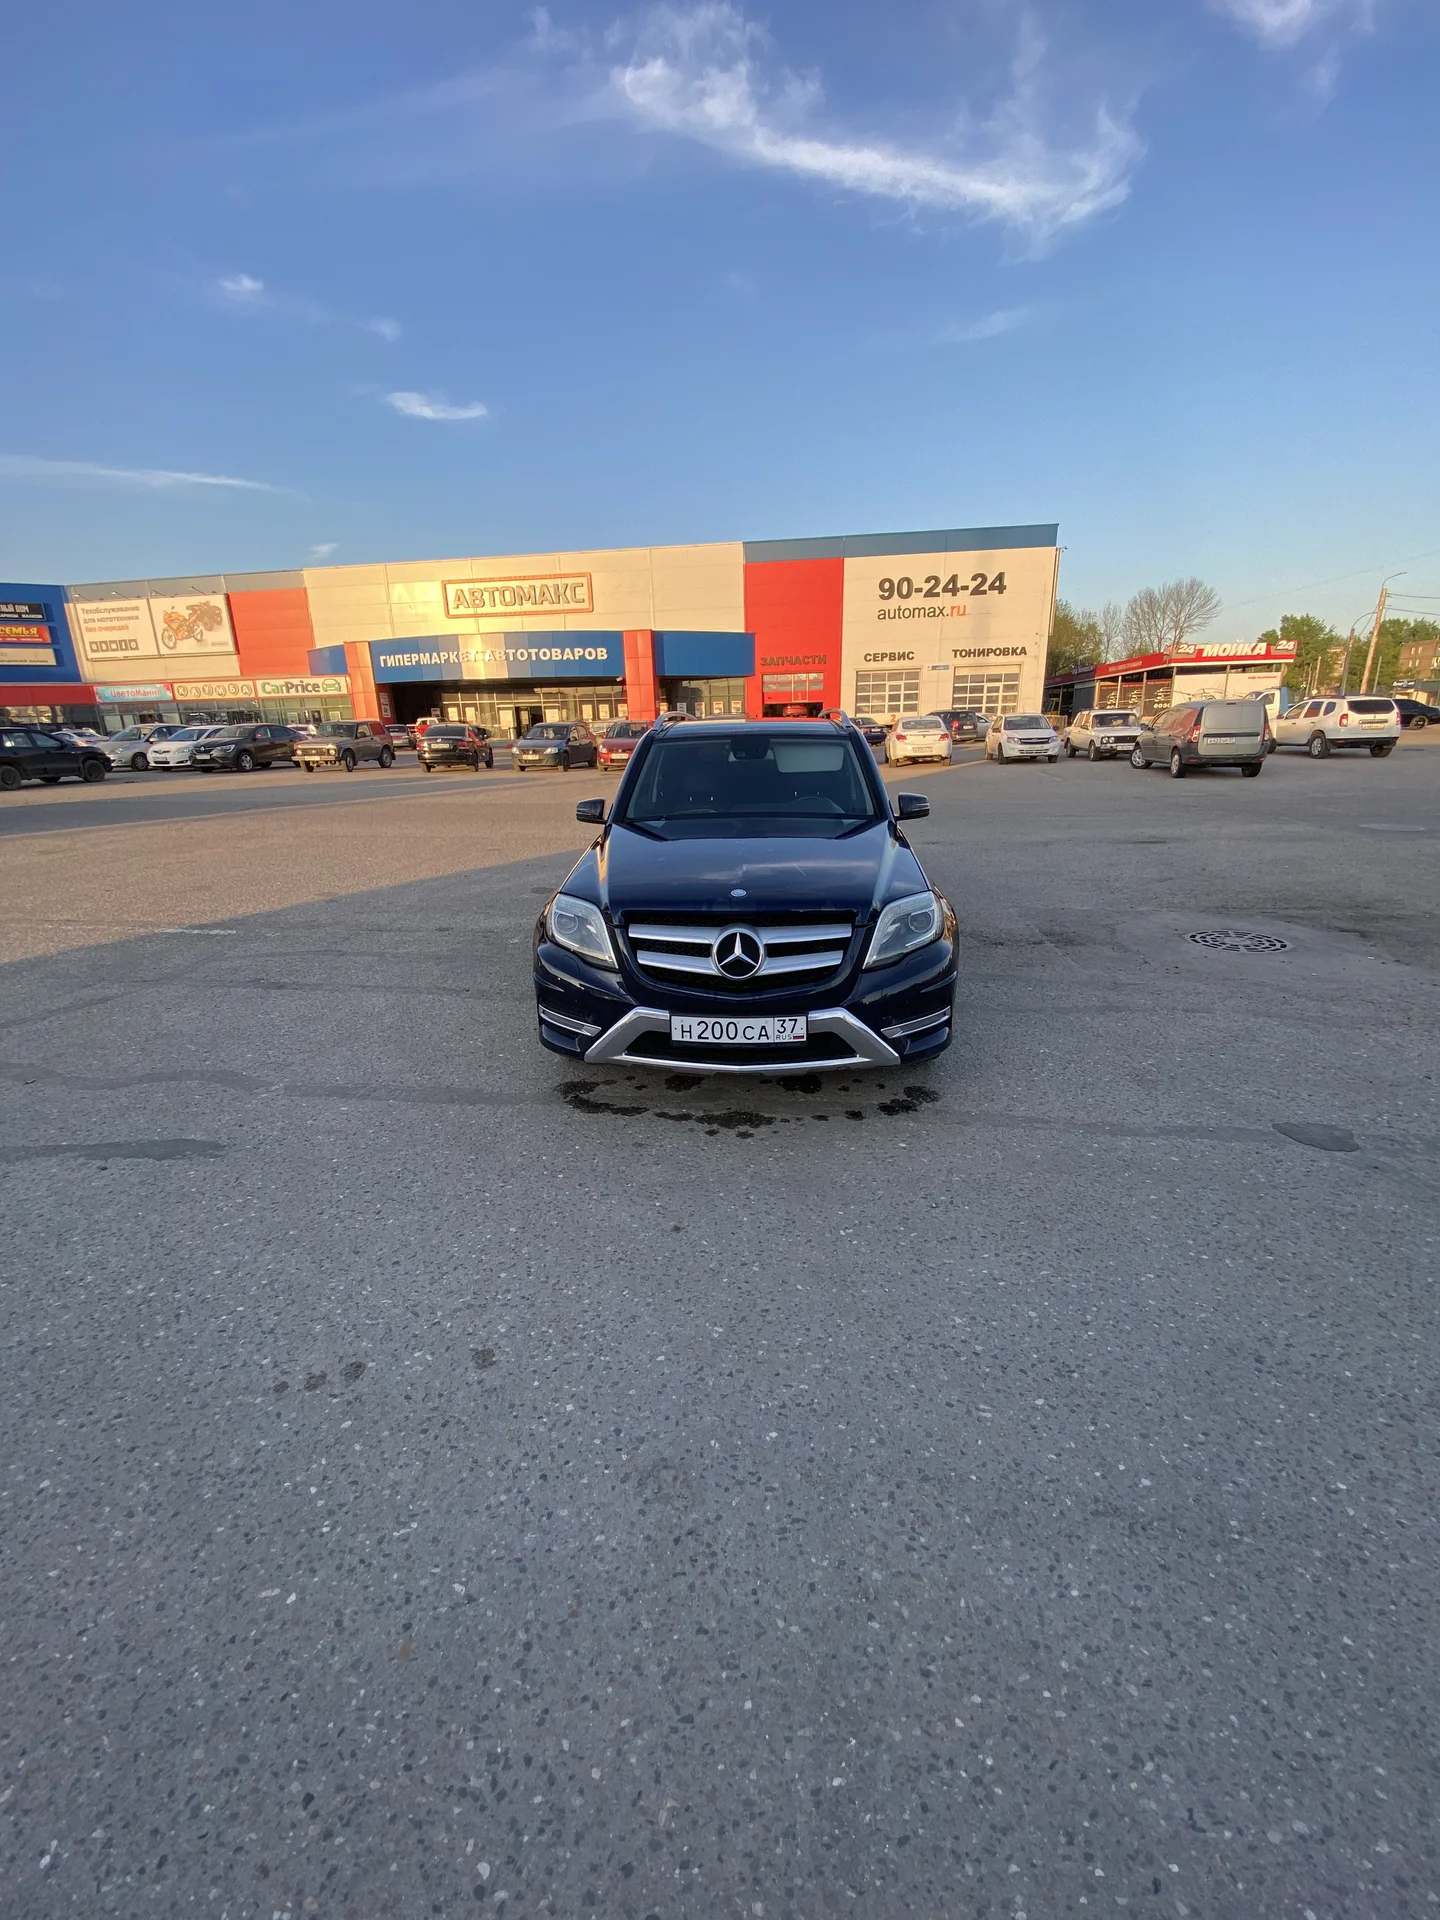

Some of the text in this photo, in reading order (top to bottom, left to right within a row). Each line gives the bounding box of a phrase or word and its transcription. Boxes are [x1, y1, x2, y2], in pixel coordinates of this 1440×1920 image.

[878, 571, 1007, 600] 90-24-24
[453, 582, 586, 609] АВТОМАКС
[97, 615, 140, 623] мототехники
[877, 604, 967, 621] automax.ru
[0, 626, 38, 635] СЕМЬЯ
[952, 646, 1028, 659] ТОНИРОВКА
[1177, 639, 1295, 657] 24 МОЙКА 24
[380, 647, 608, 667] ГИПЕРМАРКЕТ АВТОТОВАРОВ
[760, 654, 827, 667] ЗАПЧАСТИ
[864, 651, 915, 662] СЕРВИС
[110, 688, 162, 699] ЦветоМания
[176, 682, 252, 699] КЛУМБА
[261, 680, 320, 695] CarPrice
[890, 714, 897, 723] 2
[680, 1018, 798, 1041] Н200СА 37
